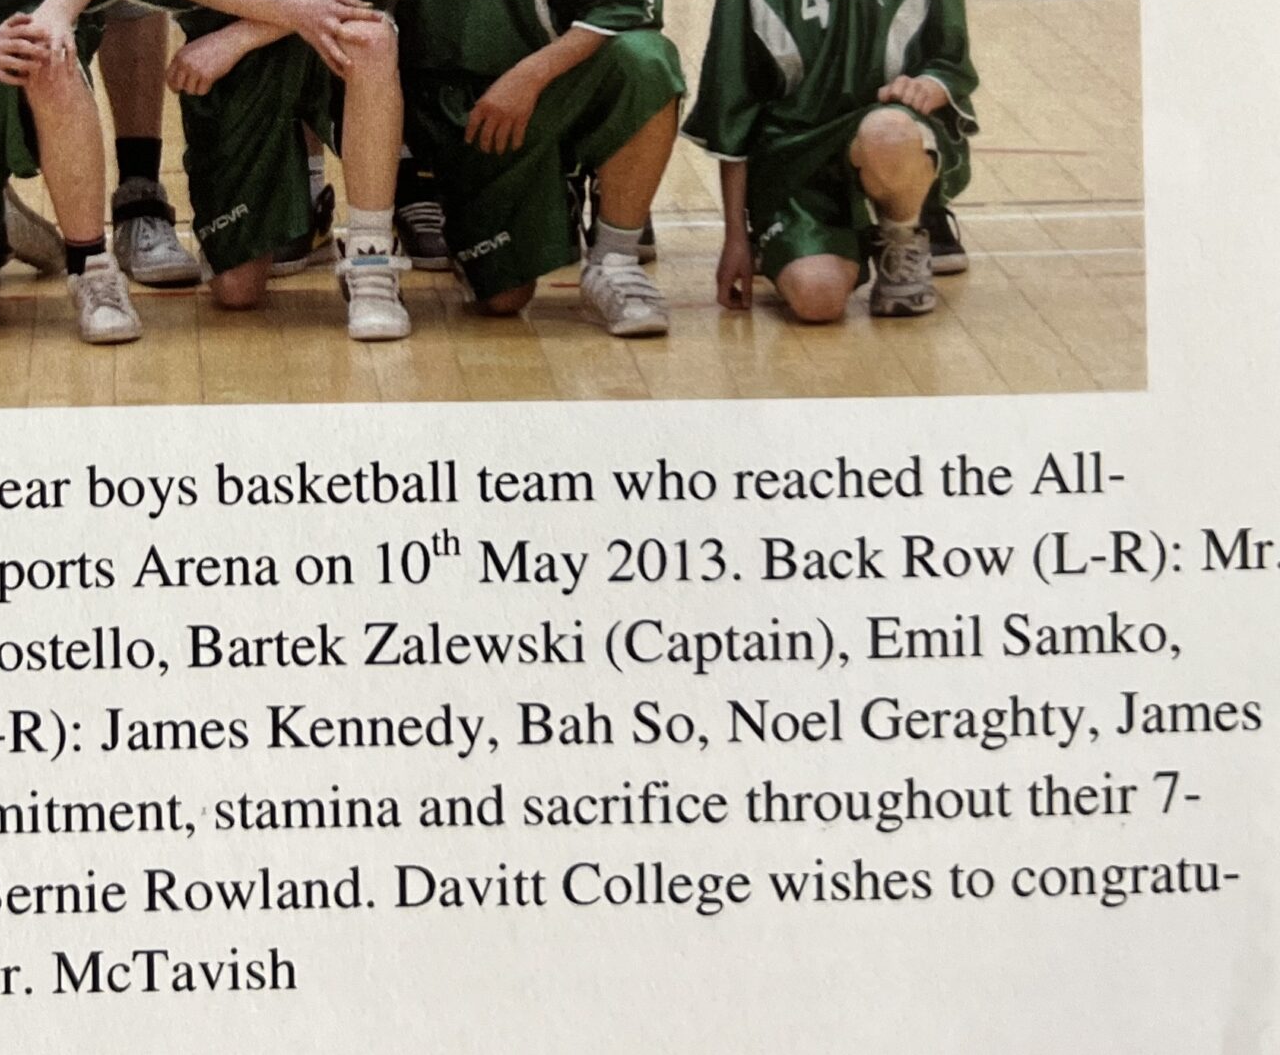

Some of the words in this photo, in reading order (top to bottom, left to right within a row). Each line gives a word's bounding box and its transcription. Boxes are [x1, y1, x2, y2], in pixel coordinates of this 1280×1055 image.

[85, 464, 199, 520] boys
[214, 459, 459, 507] basketball
[476, 465, 596, 504] team
[611, 457, 718, 502] who
[732, 454, 925, 501] reached
[939, 453, 1014, 498] the
[1029, 450, 1125, 496] All-
[131, 543, 281, 589] Arena
[295, 554, 355, 587] on
[376, 527, 462, 586] 10th
[477, 539, 590, 597] May
[606, 537, 742, 583] 2013.
[759, 535, 887, 581] Back
[900, 534, 1015, 579] Row
[1032, 529, 1182, 586] (L-R):
[186, 622, 348, 669] Bartek
[363, 619, 586, 666] Zalewski
[605, 616, 850, 676] (Captain),
[865, 613, 984, 660] Emil
[1002, 610, 1182, 661] Samko,
[100, 707, 250, 753] James
[265, 702, 499, 760] Kennedy,
[516, 700, 615, 746] Bah
[632, 700, 710, 752] So,
[726, 698, 843, 744] Noel
[860, 694, 1100, 752] Geraghty,
[1115, 691, 1263, 736] James
[214, 784, 403, 832] stamina
[418, 782, 506, 829] and
[523, 779, 729, 827] sacrifice
[745, 776, 1013, 835] throughout
[1027, 770, 1139, 818] their
[1152, 770, 1202, 814] 7-
[143, 864, 375, 913] Rowland.
[393, 862, 548, 909] Davitt
[561, 861, 752, 917] College
[768, 857, 933, 903] wishes
[948, 863, 996, 900] to
[1011, 857, 1241, 909] congratu-
[51, 946, 298, 995] McTavish
